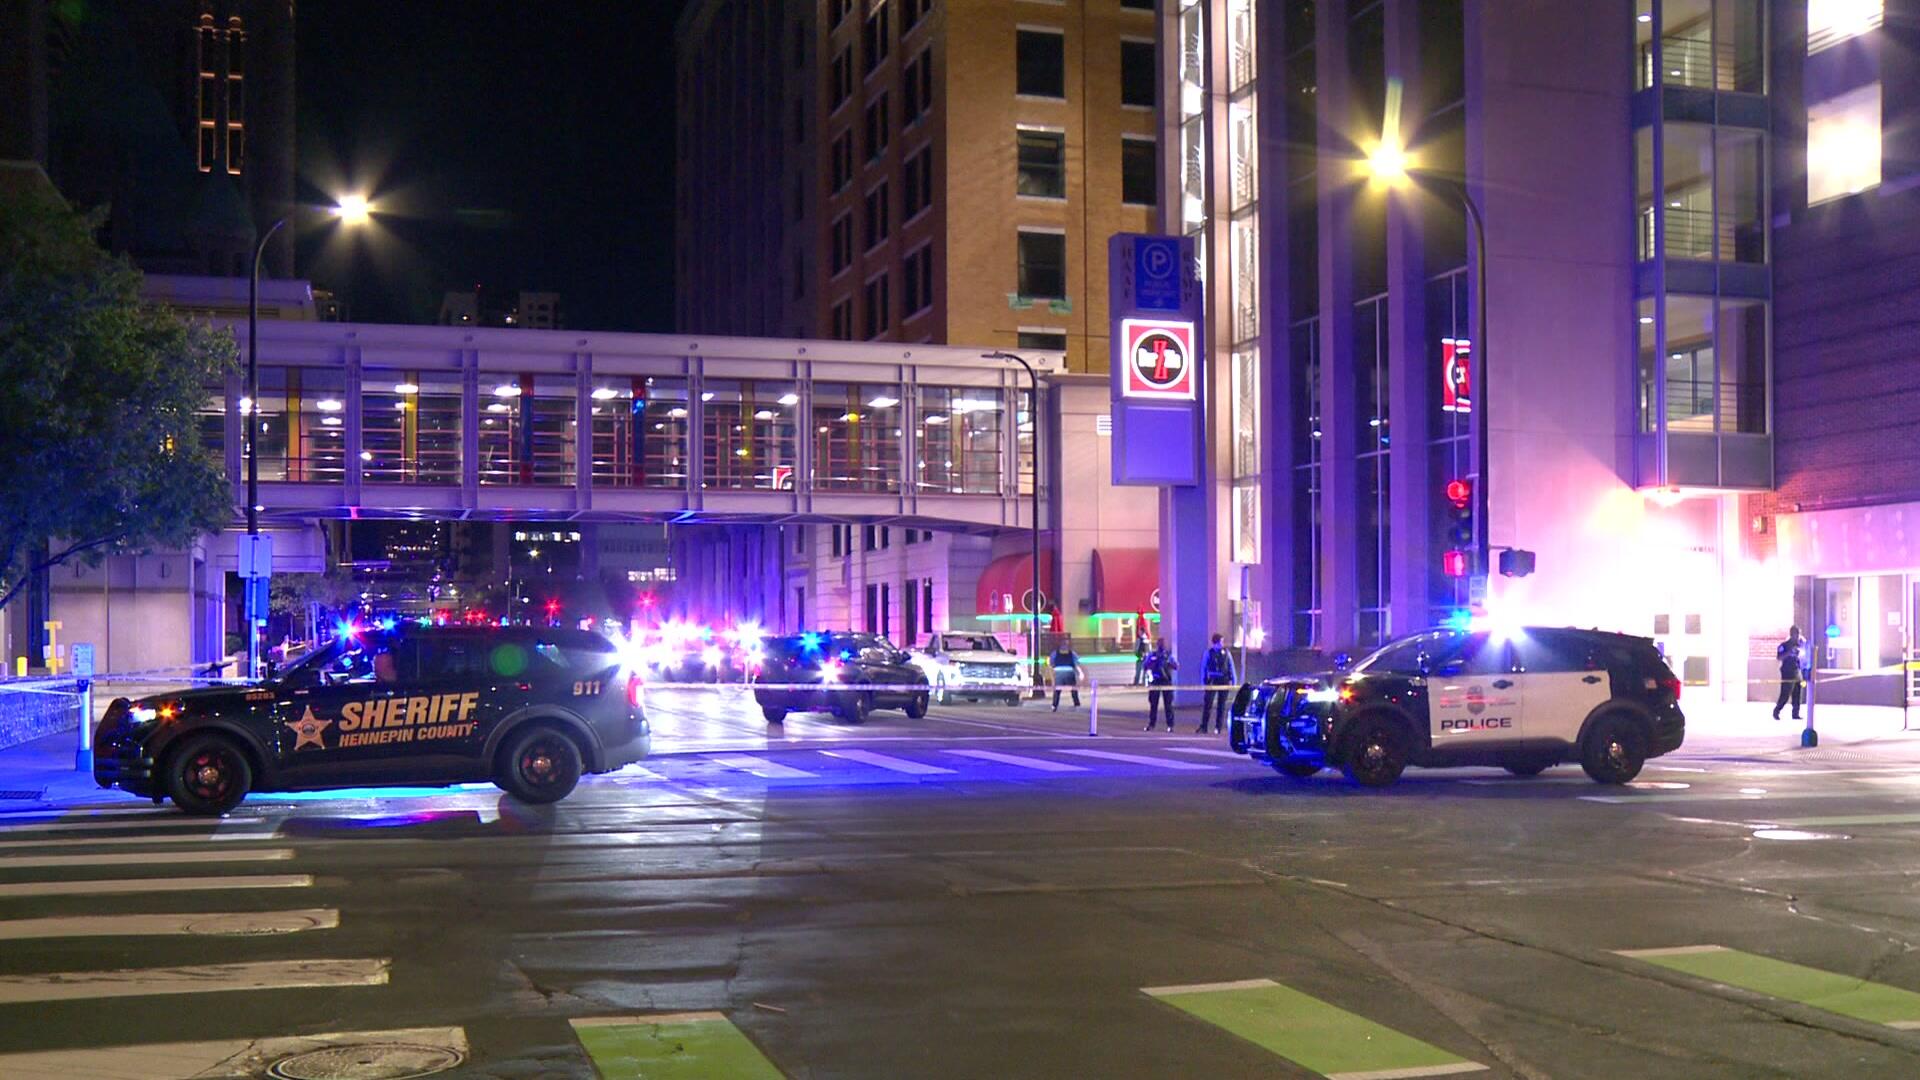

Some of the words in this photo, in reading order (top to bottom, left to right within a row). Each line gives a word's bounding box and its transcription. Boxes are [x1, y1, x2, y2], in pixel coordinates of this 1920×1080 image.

[1151, 250, 1167, 272] P
[573, 680, 601, 696] 911
[339, 692, 479, 731] SHERIFF
[1441, 717, 1512, 730] POLICE
[339, 728, 414, 747] HENNEPIN
[417, 724, 474, 740] COUNTY
